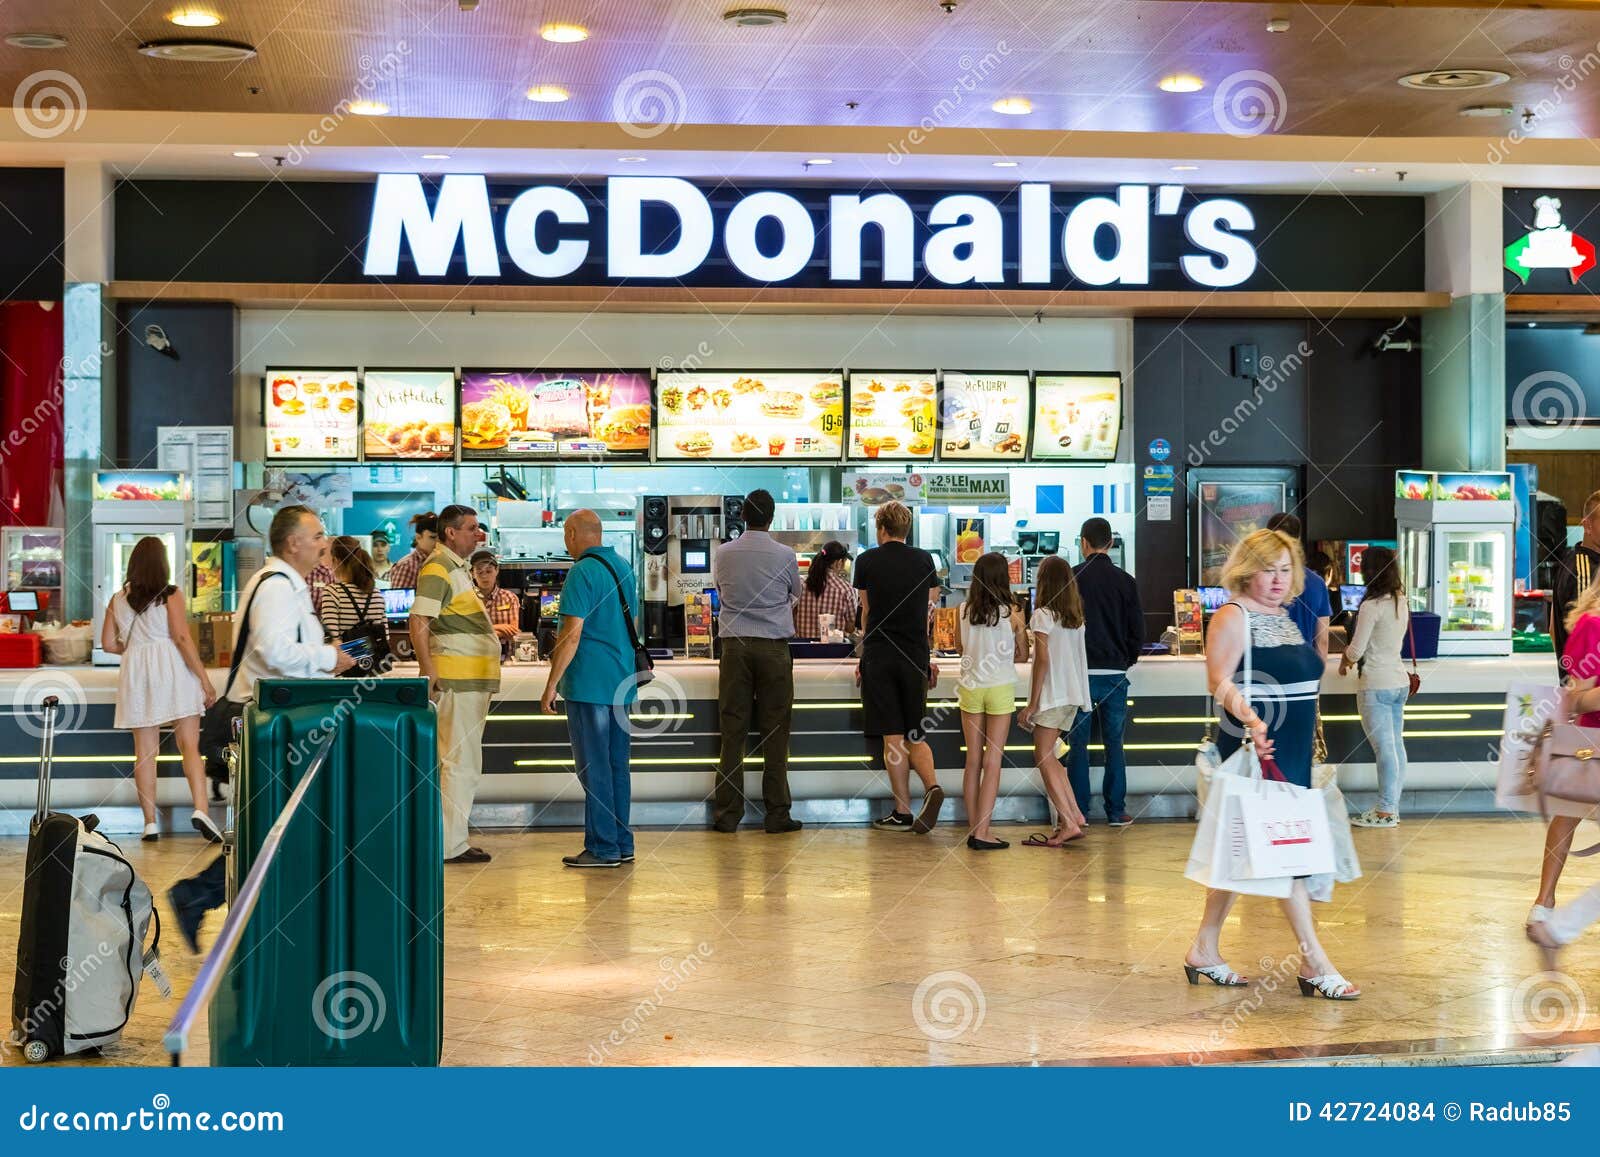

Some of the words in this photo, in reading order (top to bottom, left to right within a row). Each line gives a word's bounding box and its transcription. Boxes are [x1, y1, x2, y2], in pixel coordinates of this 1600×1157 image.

[363, 173, 1259, 288] McDonald's
[952, 476, 969, 487] LEI
[970, 480, 1005, 493] MAXI
